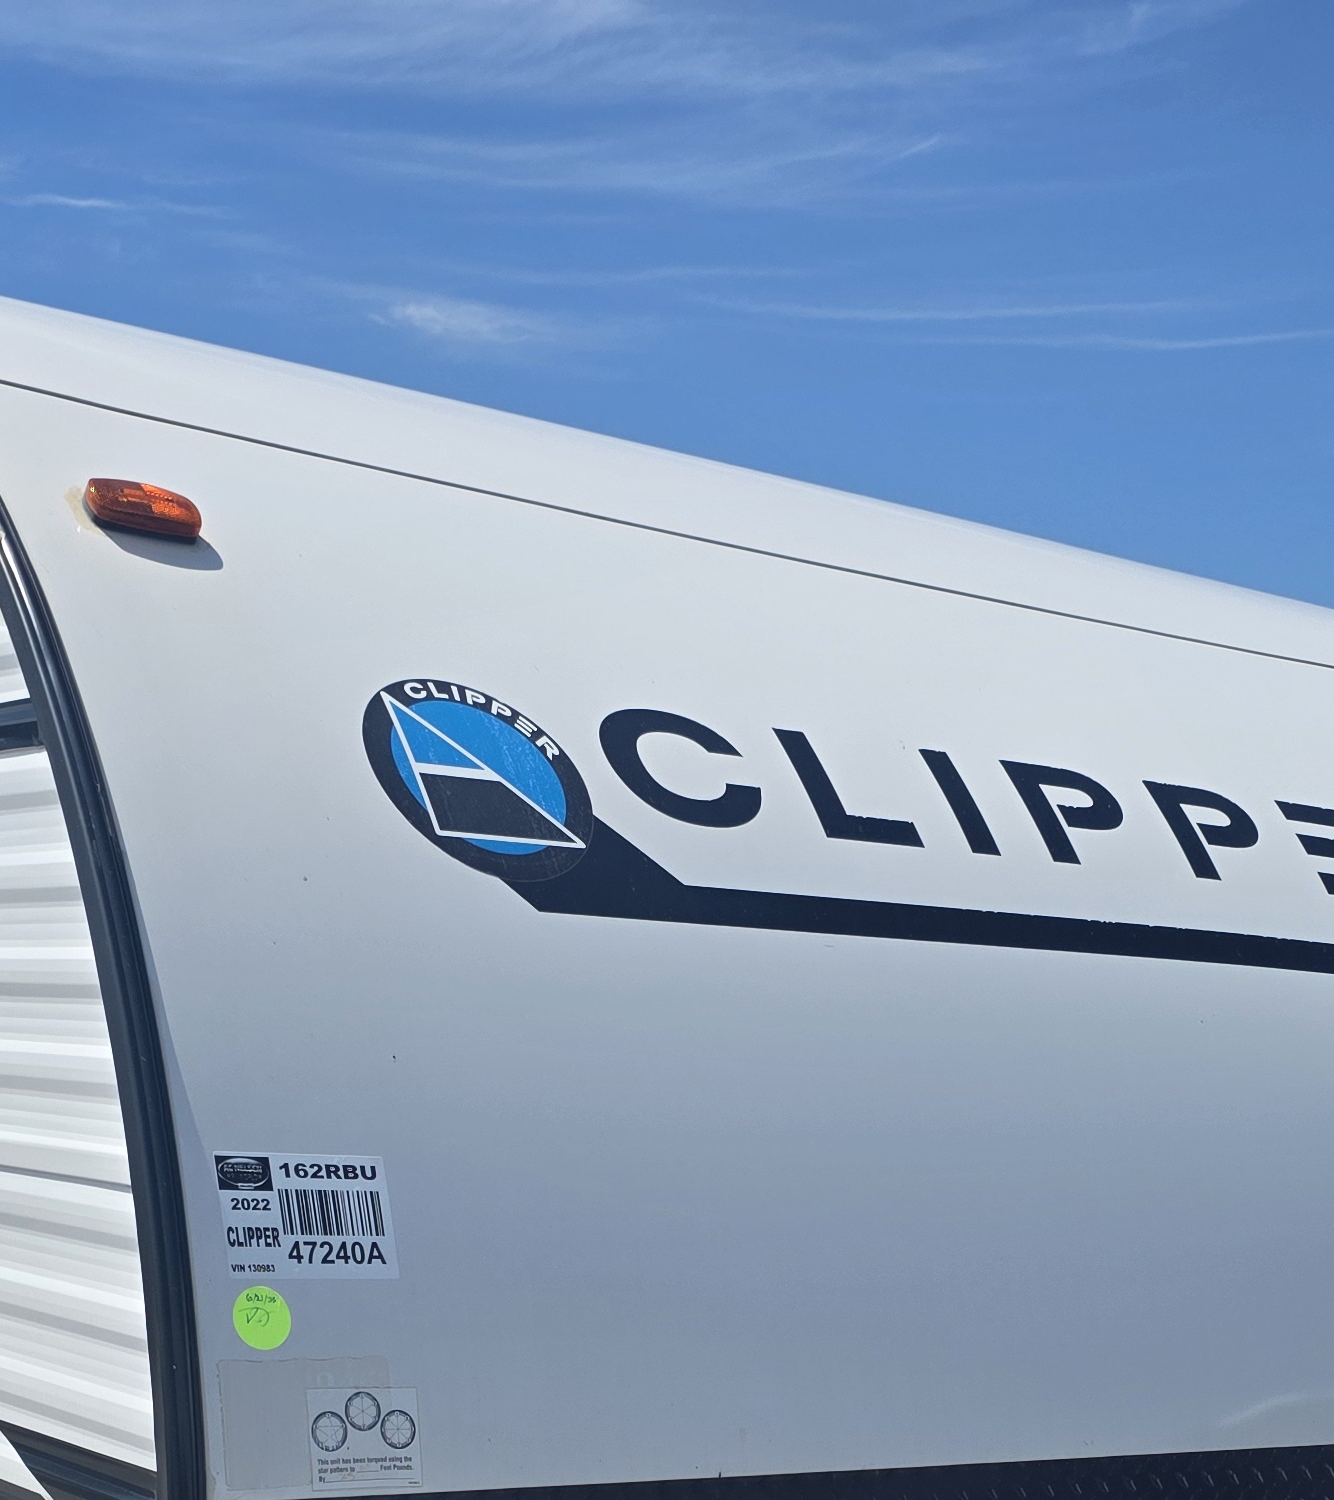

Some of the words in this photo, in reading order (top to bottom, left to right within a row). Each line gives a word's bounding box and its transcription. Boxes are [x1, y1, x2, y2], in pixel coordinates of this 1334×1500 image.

[403, 681, 560, 761] CLIPPER
[278, 1162, 377, 1181] 162RBU
[230, 1198, 272, 1211] 2022
[227, 1226, 282, 1248] CLIPPER
[288, 1241, 387, 1265] 47240A
[231, 1264, 246, 1272] VIN
[317, 1458, 329, 1466] This
